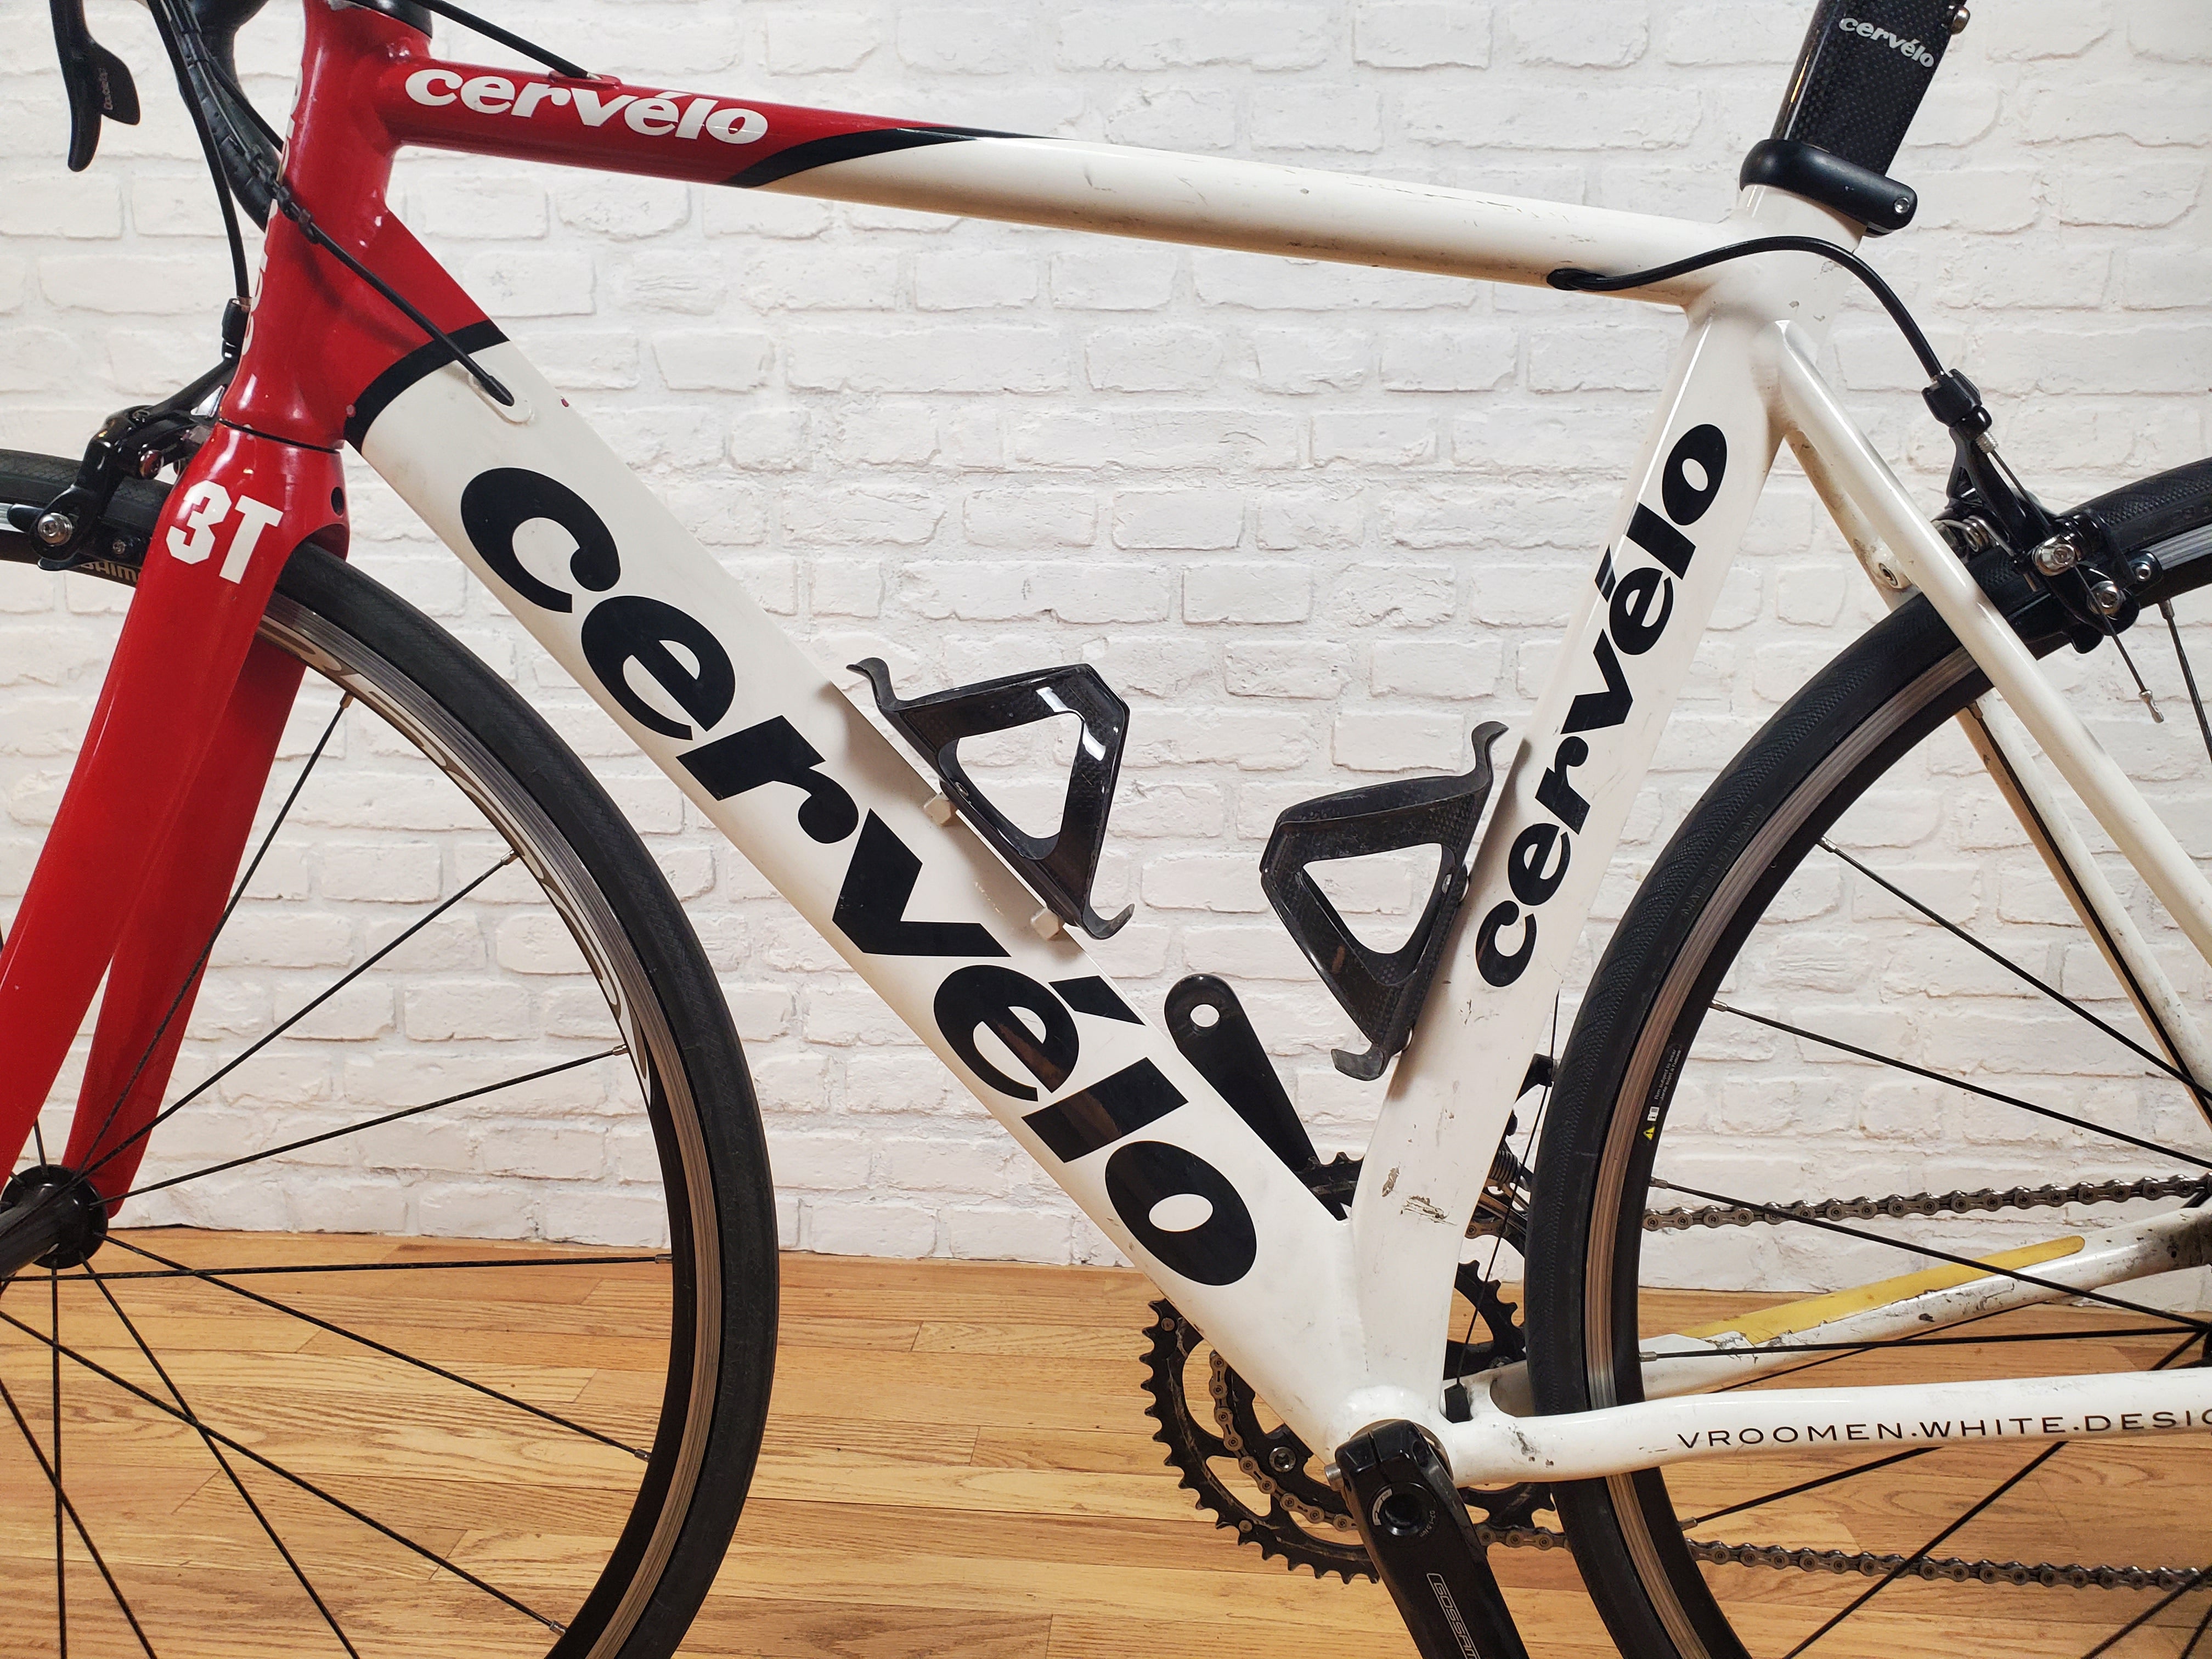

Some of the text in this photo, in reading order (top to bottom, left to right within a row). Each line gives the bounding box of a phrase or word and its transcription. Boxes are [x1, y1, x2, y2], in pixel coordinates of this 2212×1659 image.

[1839, 18, 1934, 67] cervélo
[405, 69, 768, 144] cervélo
[166, 479, 284, 584] 3T
[1476, 424, 1727, 988] cervélo
[461, 468, 1257, 1285] cervélo
